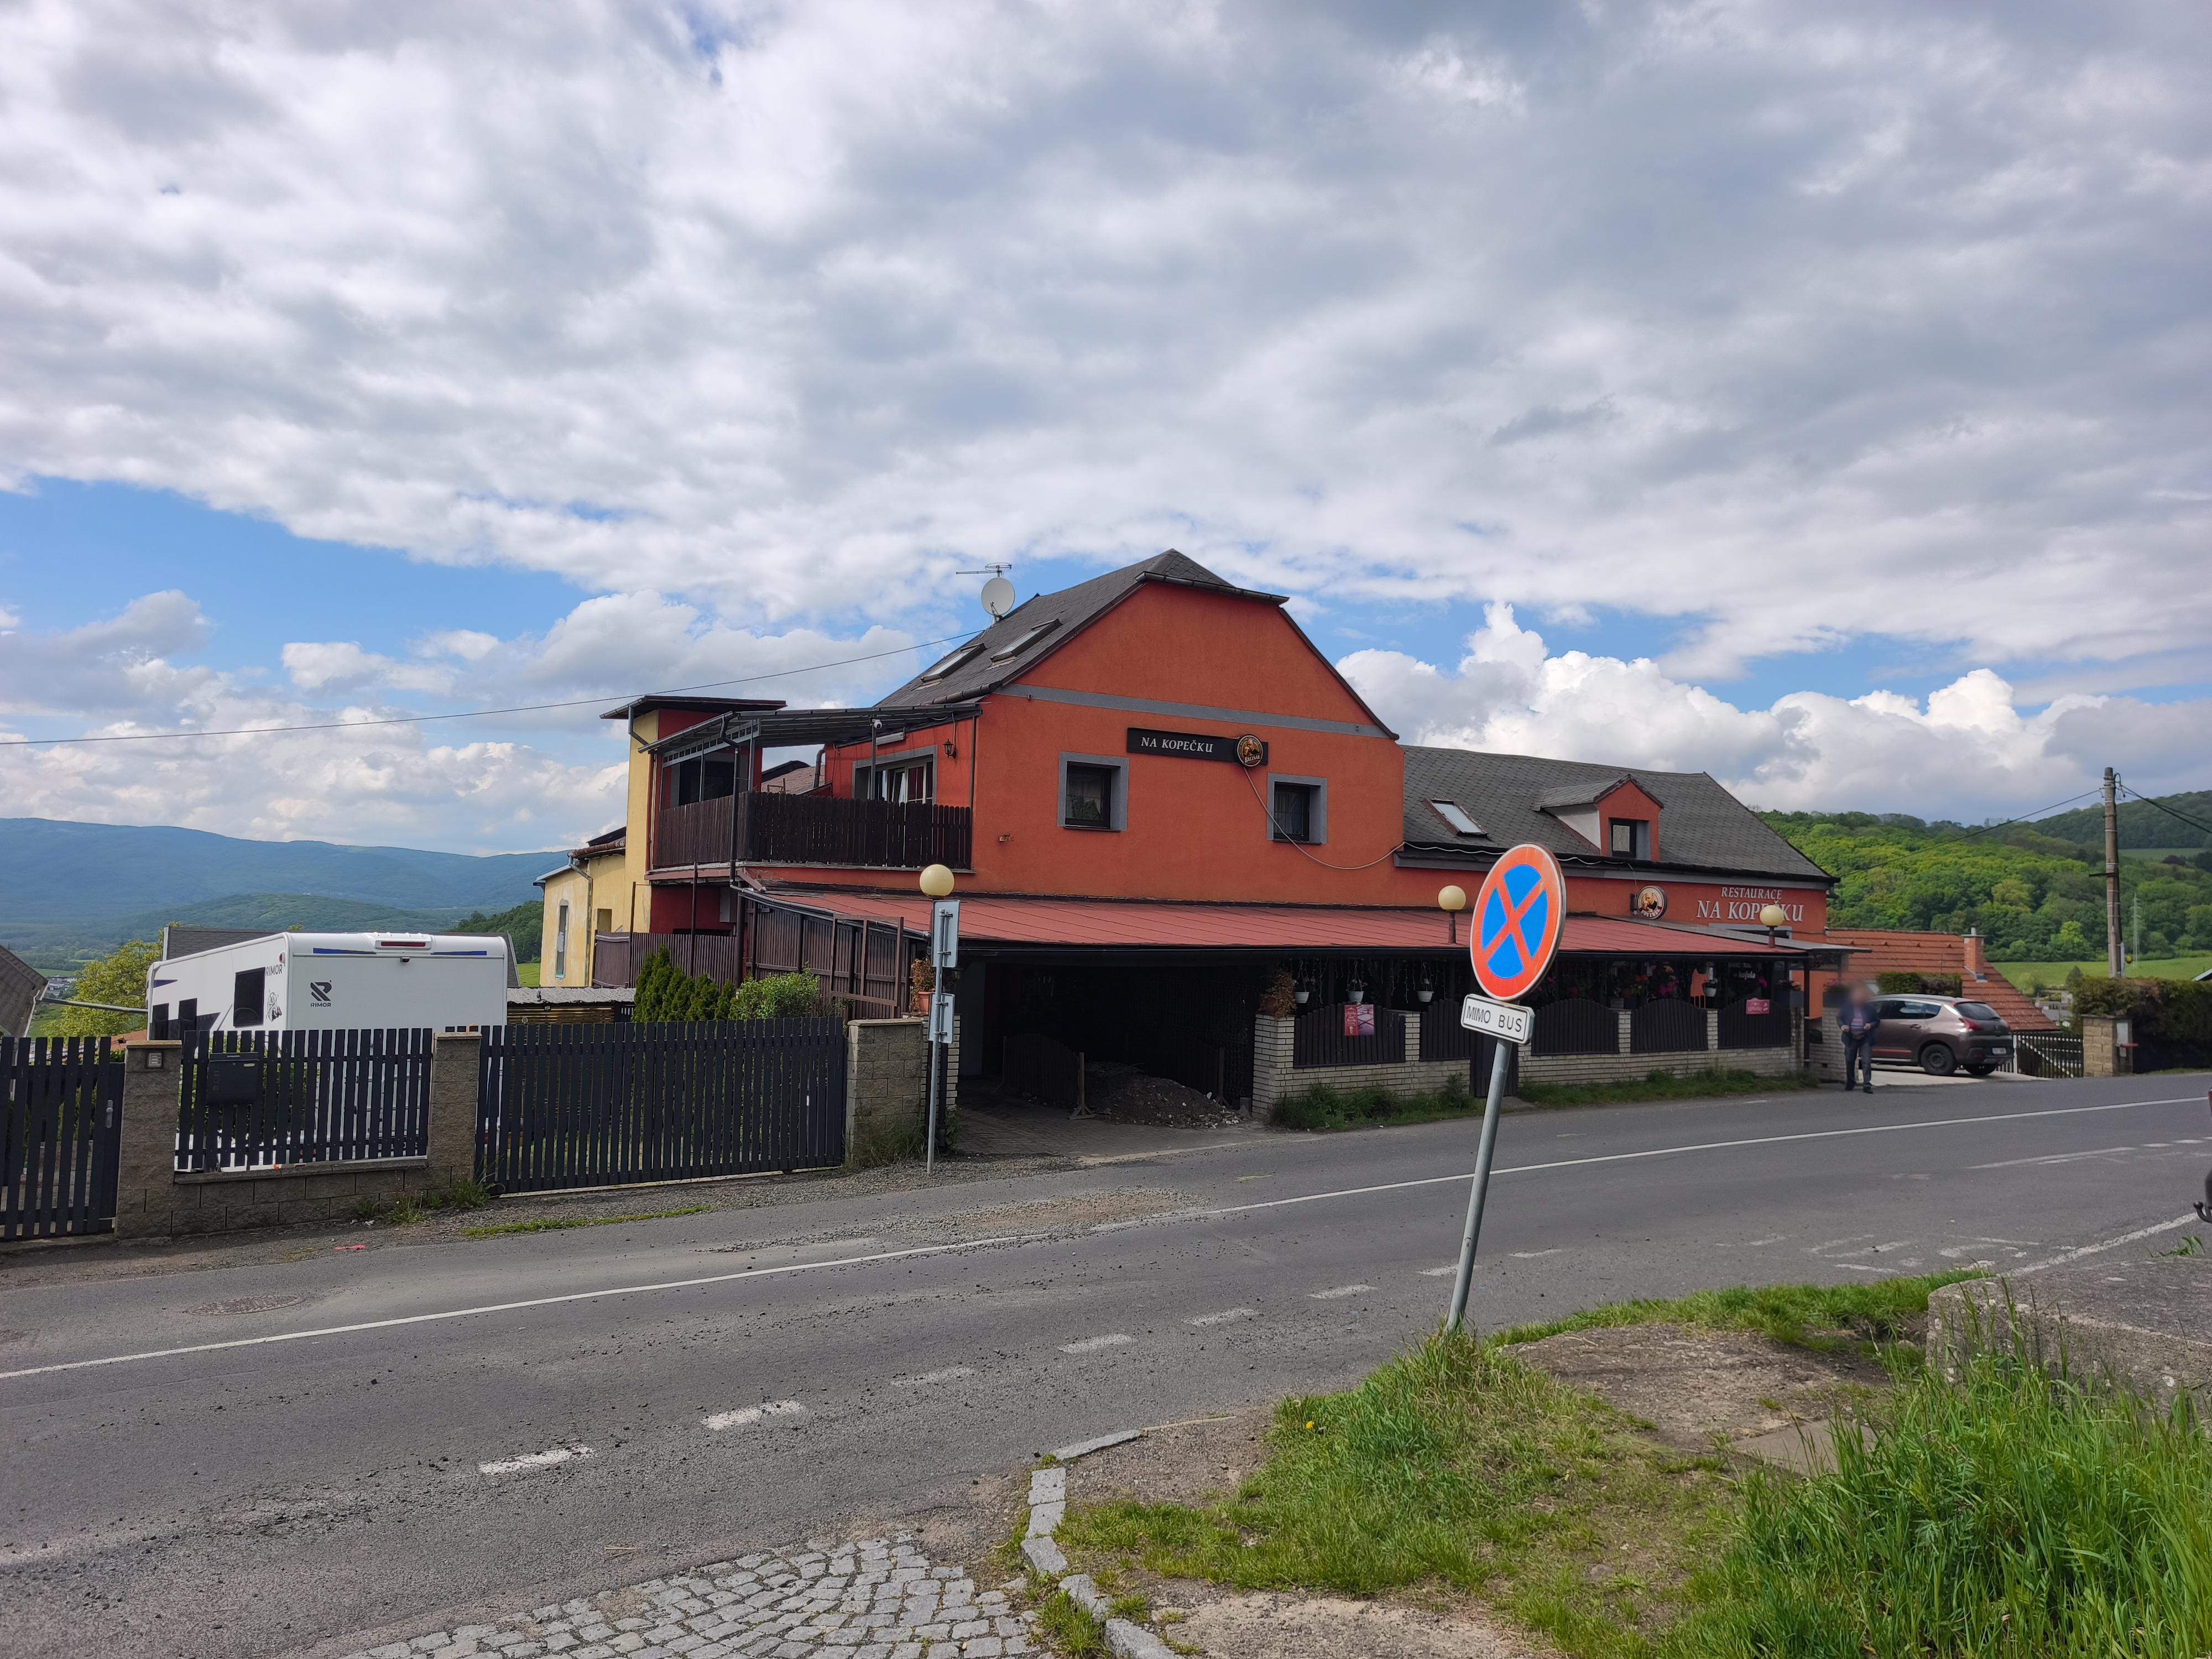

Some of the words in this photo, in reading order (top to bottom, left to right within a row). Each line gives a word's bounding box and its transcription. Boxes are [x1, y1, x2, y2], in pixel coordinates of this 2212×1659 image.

[1141, 737, 1157, 748] NA
[1161, 739, 1213, 753] KOPEČKU
[1721, 886, 1782, 900] RESTAURACE
[1696, 900, 1721, 919] NA
[1727, 900, 1804, 922] KOPKU
[265, 964, 283, 977] RIMOR
[1466, 1005, 1491, 1024] MIMO
[1498, 1014, 1522, 1032] BUS
